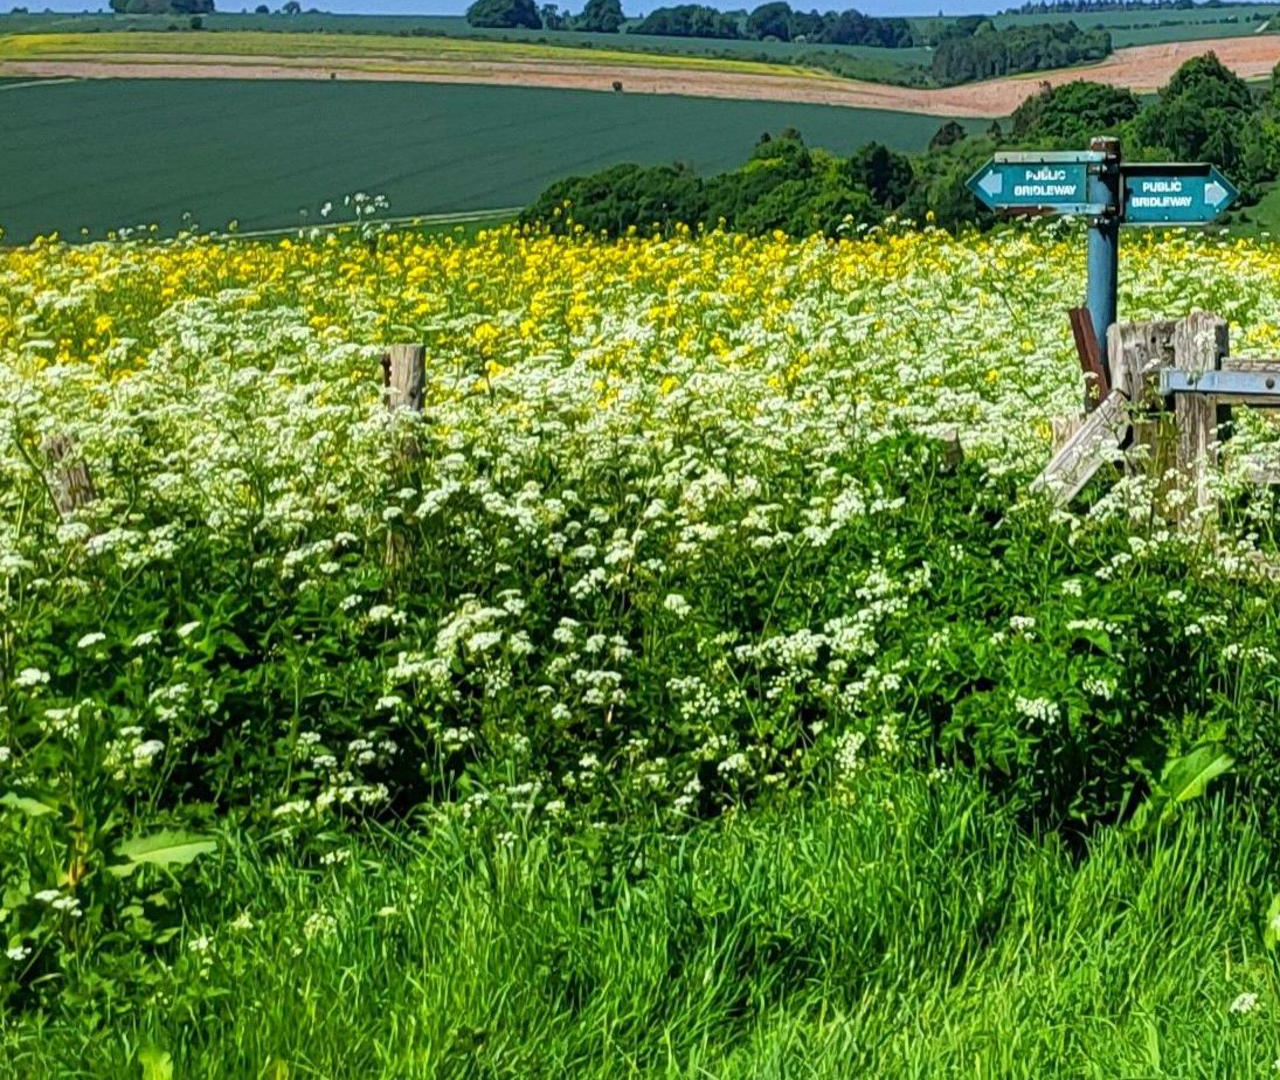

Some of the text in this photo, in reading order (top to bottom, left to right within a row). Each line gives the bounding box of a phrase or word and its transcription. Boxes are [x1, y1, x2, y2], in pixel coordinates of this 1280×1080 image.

[1025, 170, 1066, 181] PUBLIC
[1014, 185, 1077, 196] BRIDLEWAY
[1142, 181, 1182, 193] PUBLIC
[1131, 196, 1192, 207] BRIDLEWAY
